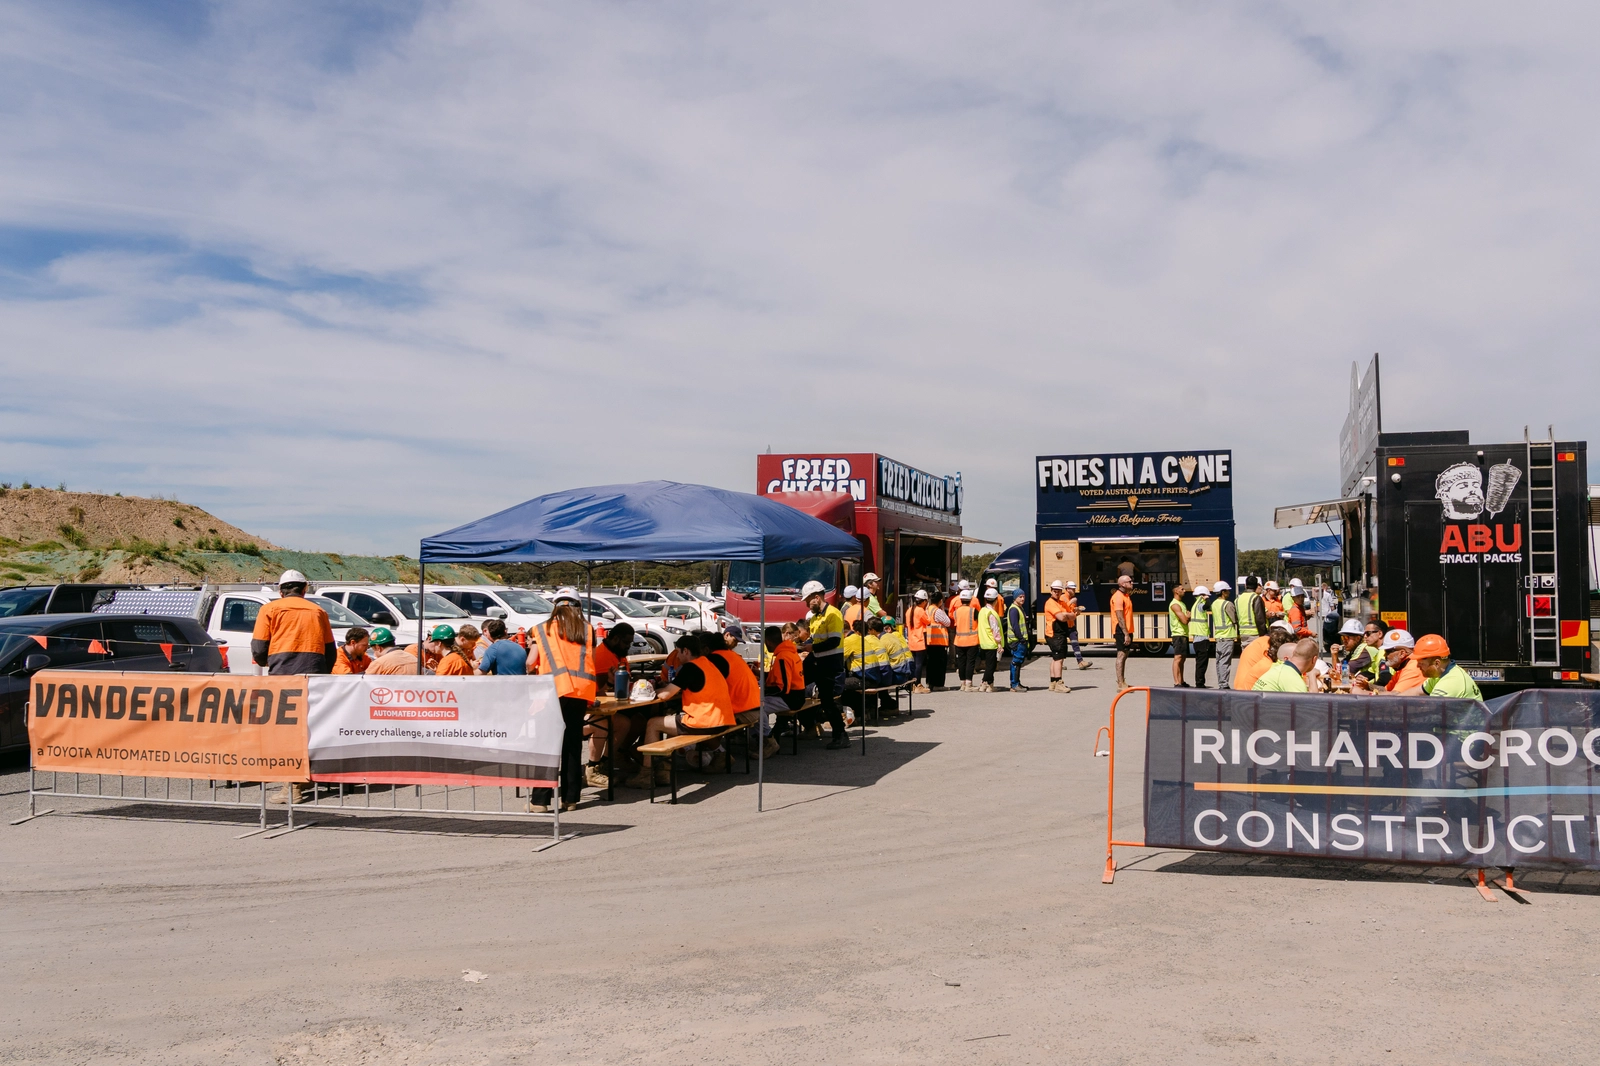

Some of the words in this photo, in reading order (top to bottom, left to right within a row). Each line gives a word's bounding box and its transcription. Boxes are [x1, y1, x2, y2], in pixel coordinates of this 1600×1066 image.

[782, 458, 851, 480] FRIED
[1038, 457, 1104, 487] FRIES
[1109, 457, 1134, 485] IN
[1140, 456, 1157, 484] A
[882, 458, 910, 500] FRIED
[910, 469, 945, 511] CHICKEN
[1105, 488, 1151, 496] AUSTRALIA'S
[1153, 487, 1161, 495] #1
[1086, 515, 1117, 524] Nilla's
[1118, 514, 1155, 526] Belgian
[1157, 513, 1182, 523] Fries
[1440, 524, 1522, 553] ABU
[1439, 554, 1478, 564] SNACK
[1483, 553, 1522, 563] PACKS
[35, 683, 303, 725] VANDERLANDE
[394, 690, 458, 704] TOYOTA
[373, 710, 417, 718] AUTOMATED
[418, 710, 455, 718] LOGISTICS
[339, 728, 354, 736] For
[355, 729, 379, 738] every
[380, 728, 424, 738] challenge,
[433, 729, 468, 738] reliable
[470, 729, 507, 738] solution
[37, 748, 44, 756] a
[47, 746, 92, 758] TOYOTA
[96, 747, 170, 762] AUTOMATED
[174, 752, 237, 765] LOGISTICS
[241, 755, 302, 769] company
[1193, 728, 1444, 769] RICHARD
